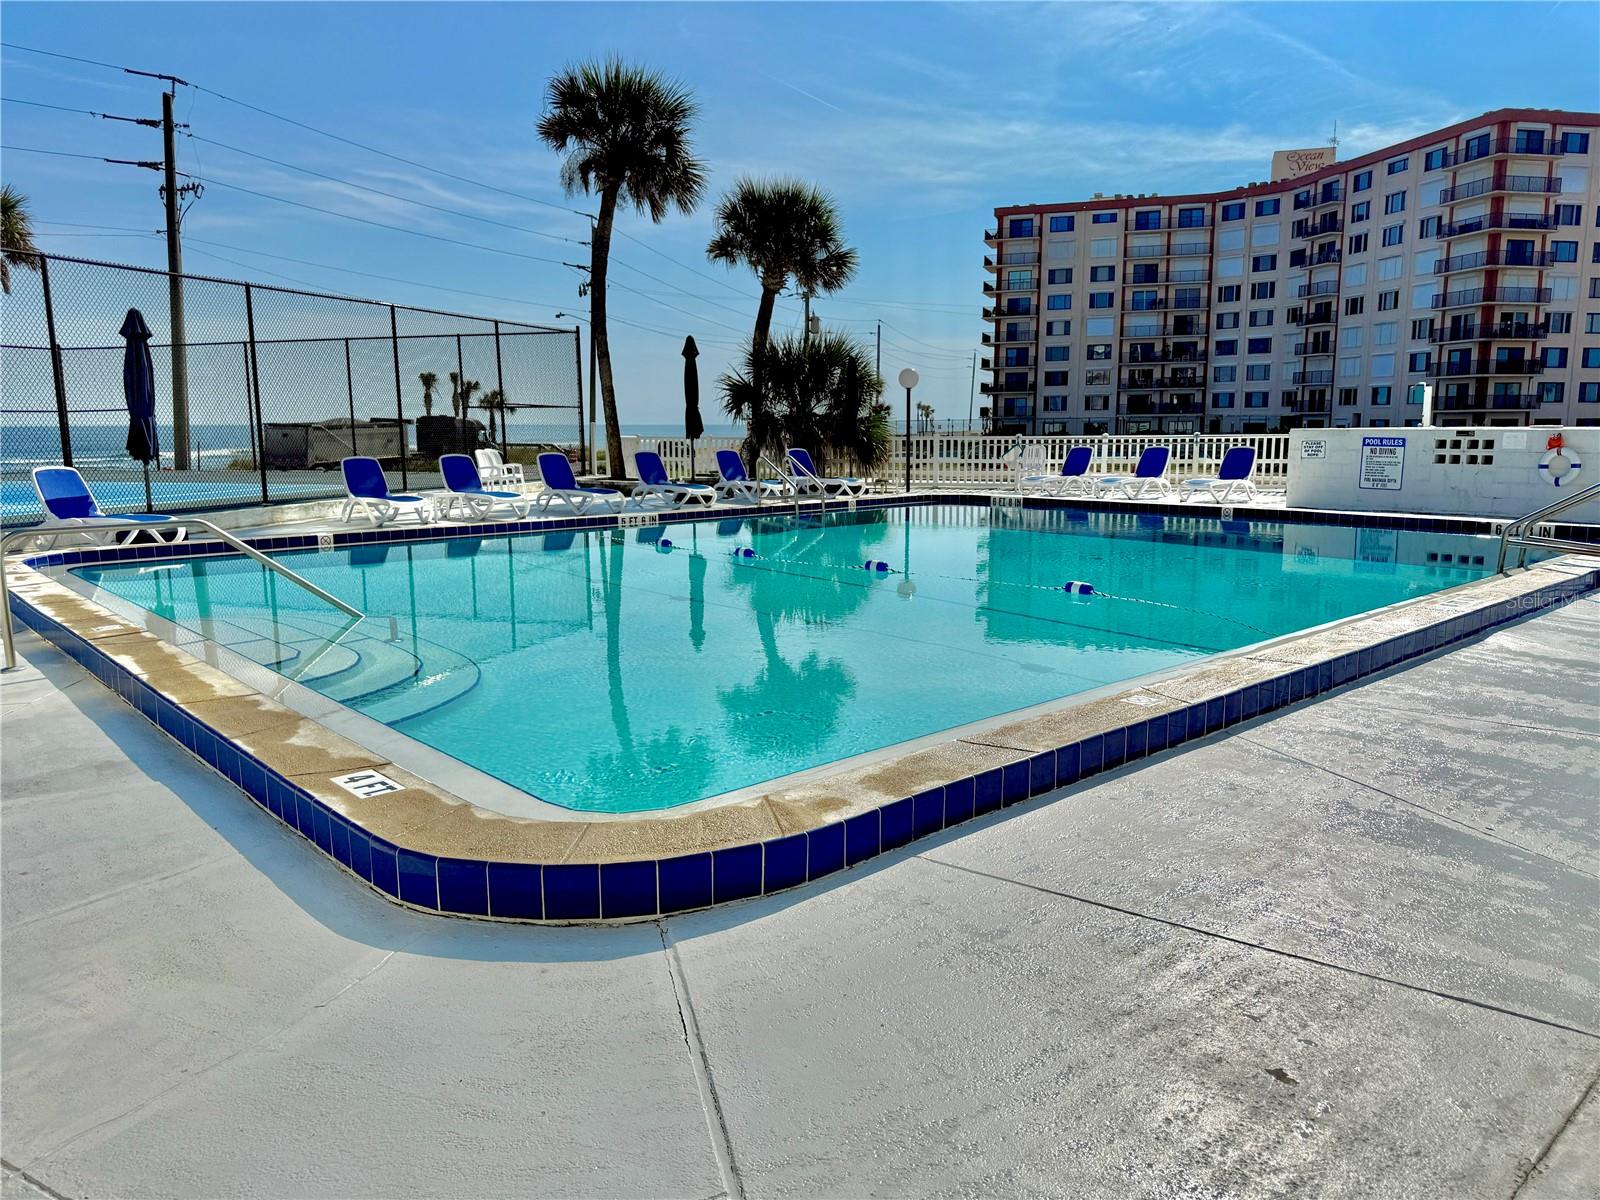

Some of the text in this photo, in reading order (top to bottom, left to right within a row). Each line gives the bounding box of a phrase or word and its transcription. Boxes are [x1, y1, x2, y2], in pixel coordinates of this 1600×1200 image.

[1287, 151, 1324, 161] Ocean
[1289, 160, 1325, 171] View
[1365, 438, 1403, 447] POOL RULES
[1369, 447, 1397, 456] NO DIVING
[621, 517, 626, 525] 5
[629, 516, 639, 525] FT
[649, 515, 657, 524] IN
[1495, 524, 1503, 536] 6
[1538, 526, 1552, 539] IN
[344, 774, 376, 784] 4
